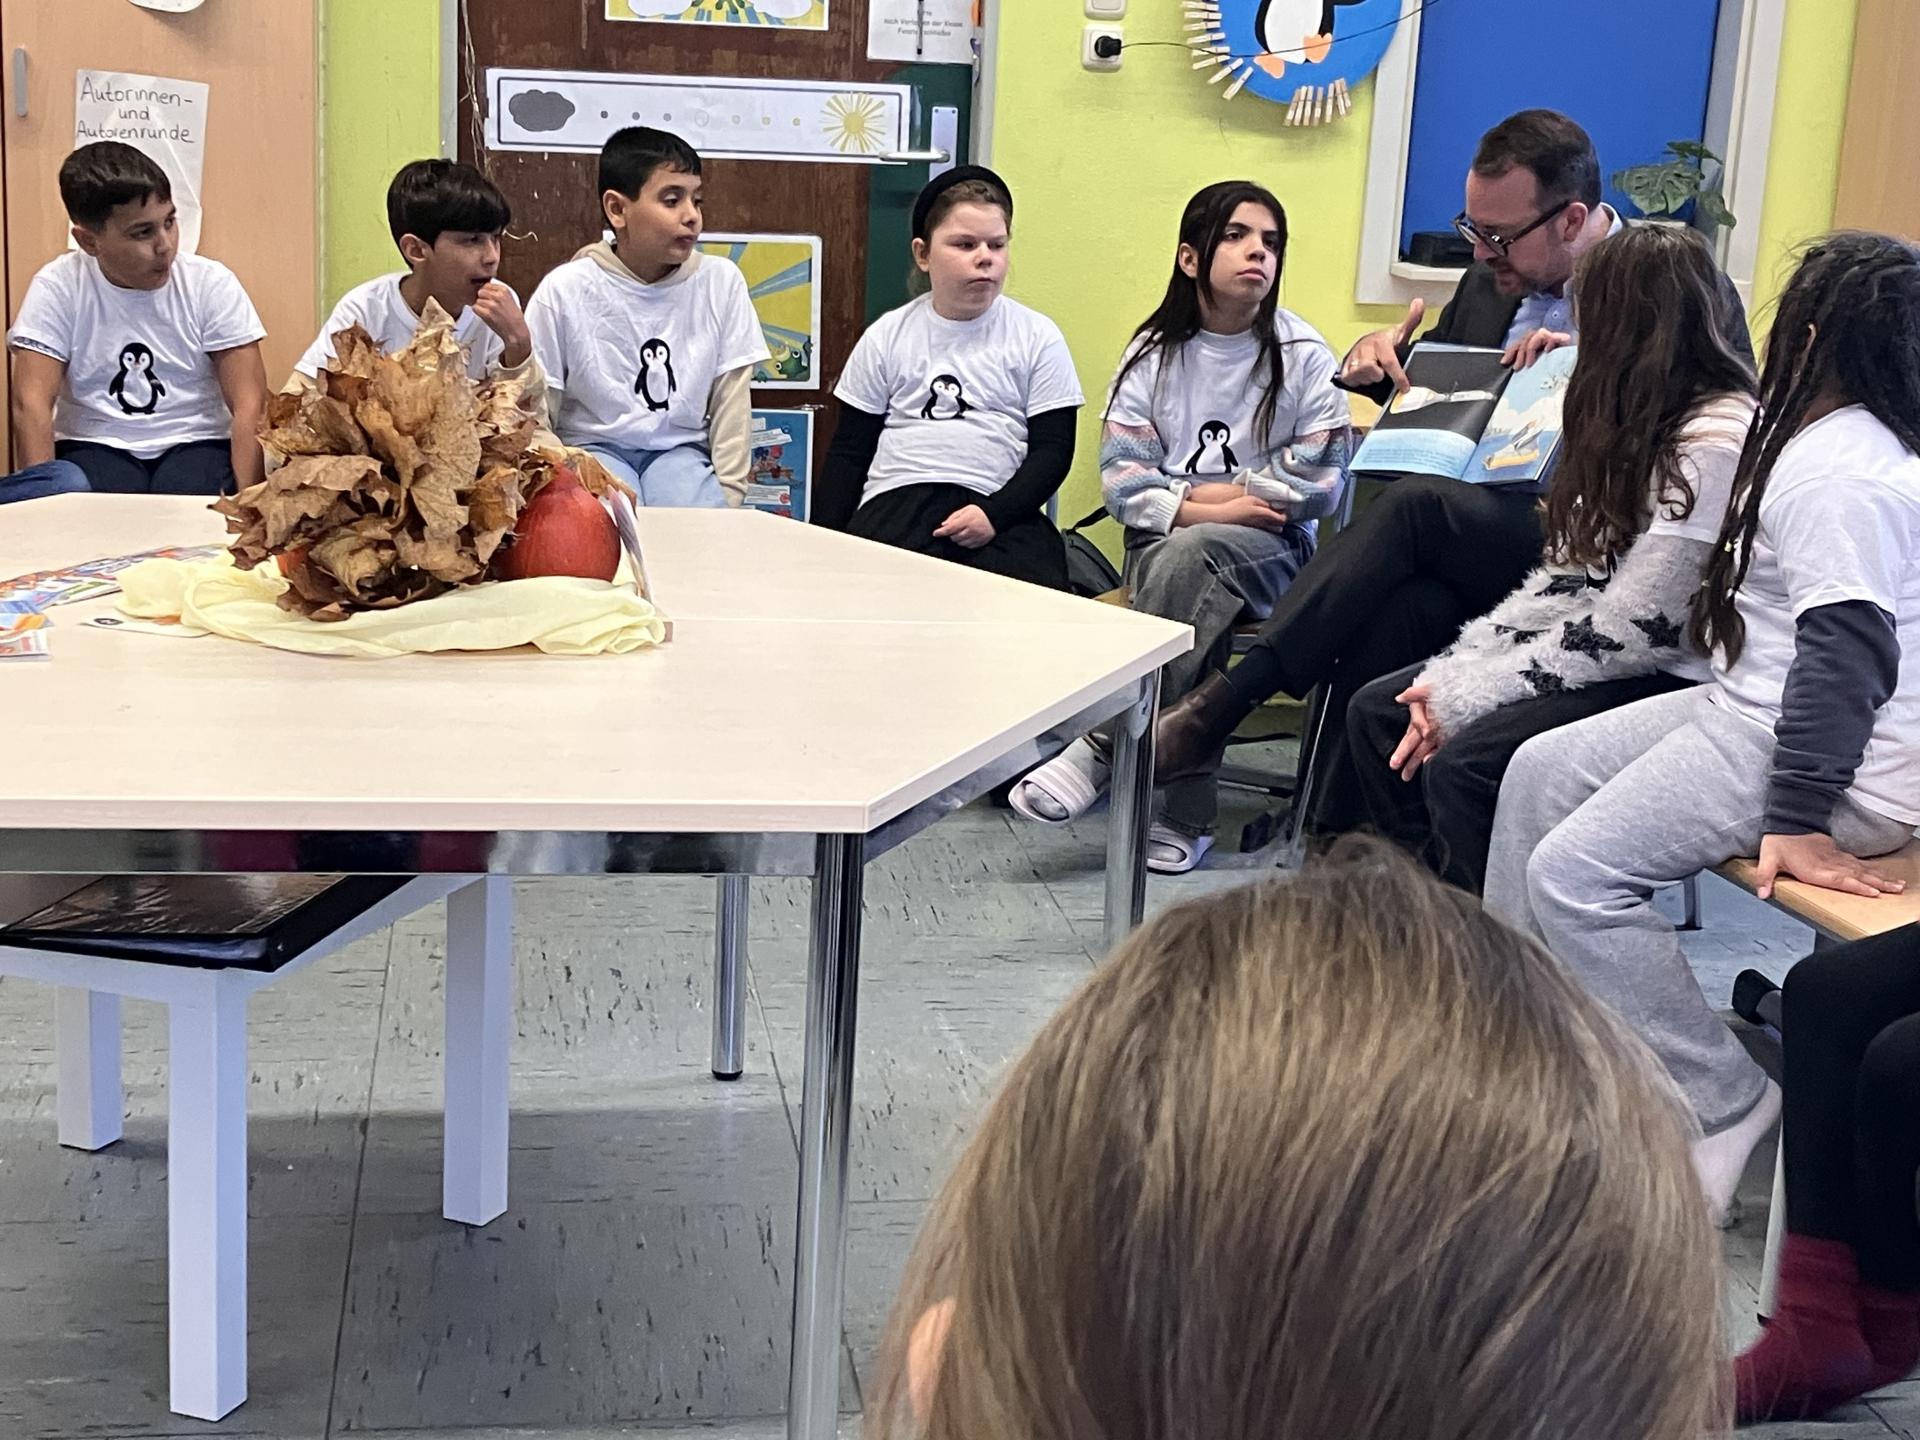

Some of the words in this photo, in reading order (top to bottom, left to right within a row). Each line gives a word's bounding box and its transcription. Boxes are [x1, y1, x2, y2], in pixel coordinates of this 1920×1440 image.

[80, 76, 193, 107] Autorinnen-
[118, 105, 150, 121] und
[77, 120, 195, 144] Autorenrunde
